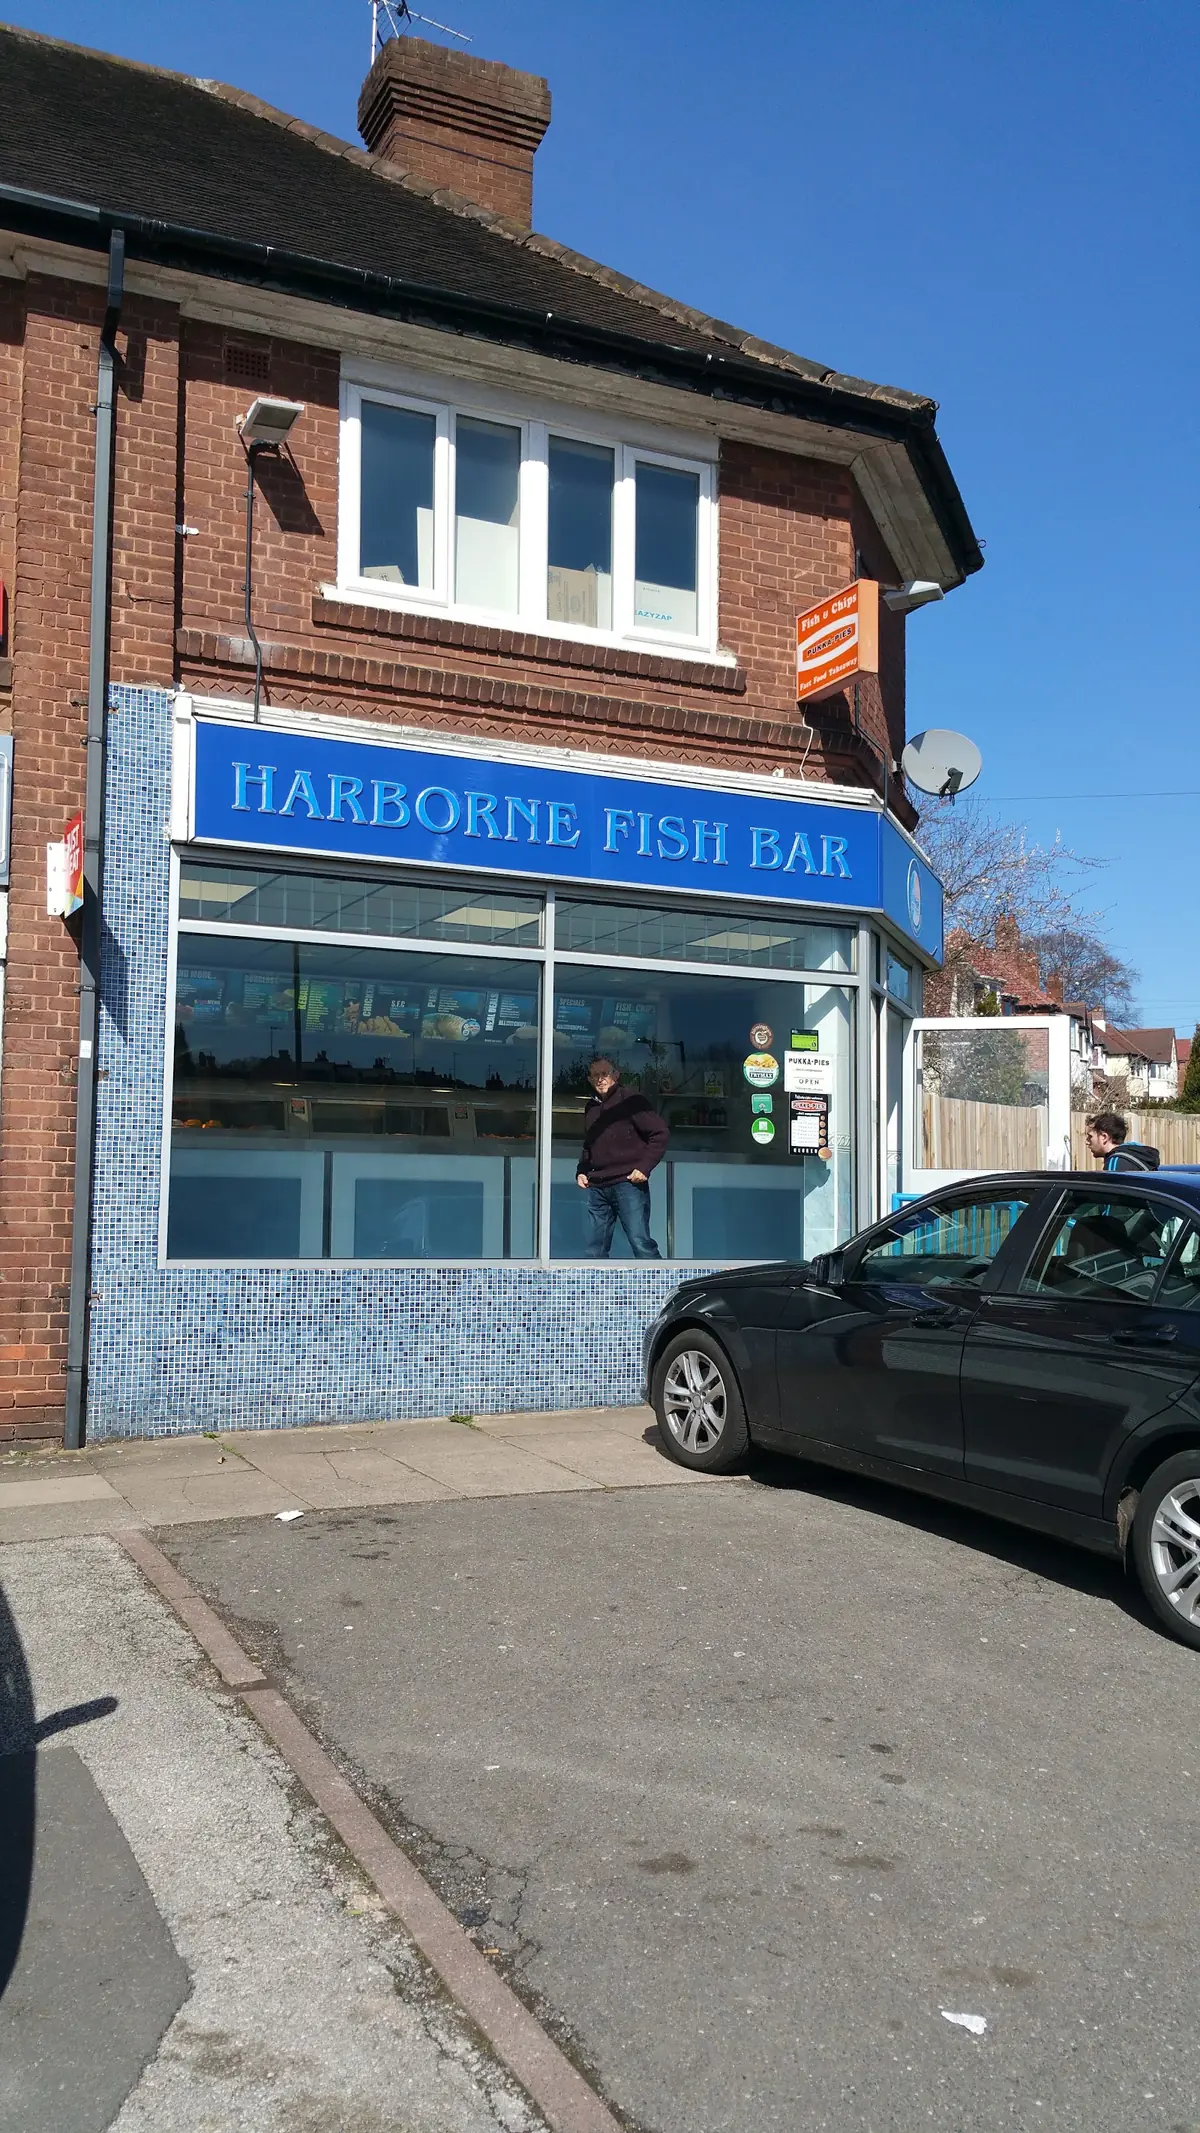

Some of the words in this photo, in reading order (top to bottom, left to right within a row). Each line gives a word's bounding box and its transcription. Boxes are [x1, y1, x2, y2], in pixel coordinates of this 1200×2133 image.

[635, 610, 673, 621] AZYZAP
[801, 613, 820, 632] Fish
[822, 610, 829, 619] &
[831, 593, 857, 614] Chips
[799, 679, 812, 691] Fast
[813, 671, 827, 684] Food
[829, 657, 858, 675] Takeaway
[231, 761, 581, 849] HARBORNE
[603, 807, 729, 866] FISH
[750, 825, 854, 880] BAR
[297, 980, 309, 1010] KEBABS
[362, 984, 376, 1017] CHICKEN
[427, 988, 438, 1008] PIES
[615, 1002, 632, 1012] FISH
